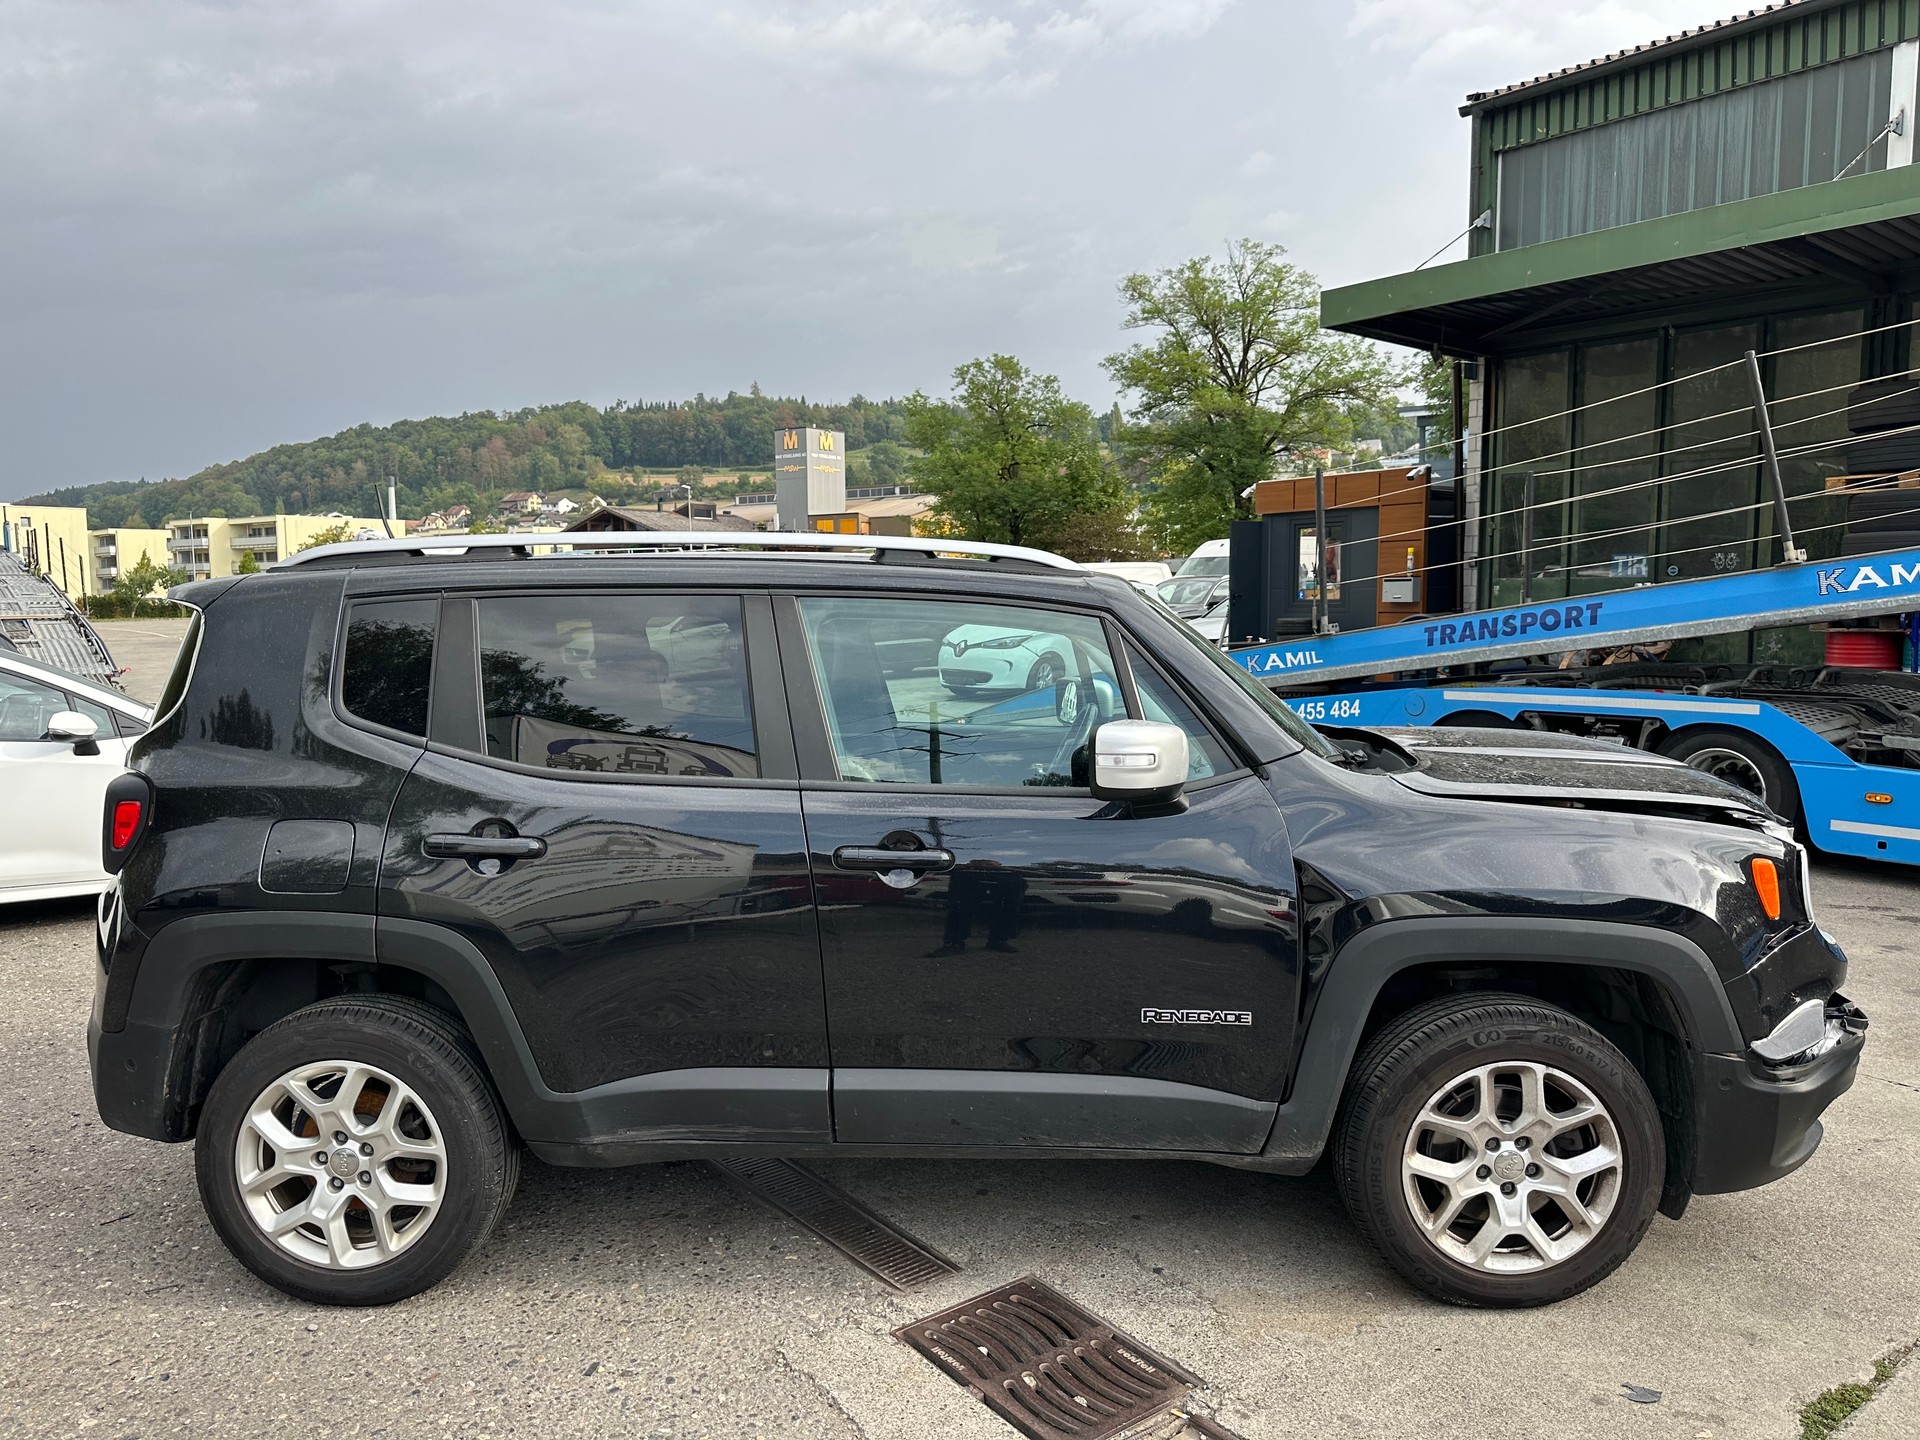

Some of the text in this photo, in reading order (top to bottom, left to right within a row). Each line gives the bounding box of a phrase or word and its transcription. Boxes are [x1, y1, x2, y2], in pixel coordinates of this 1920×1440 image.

[1613, 555, 1648, 576] TIR
[1424, 602, 1603, 647] TRANSPORT
[1246, 650, 1324, 673] KAMIL
[1330, 699, 1361, 719] 484
[1141, 1007, 1252, 1026] RENEGADE
[1542, 1034, 1585, 1056] 215/60
